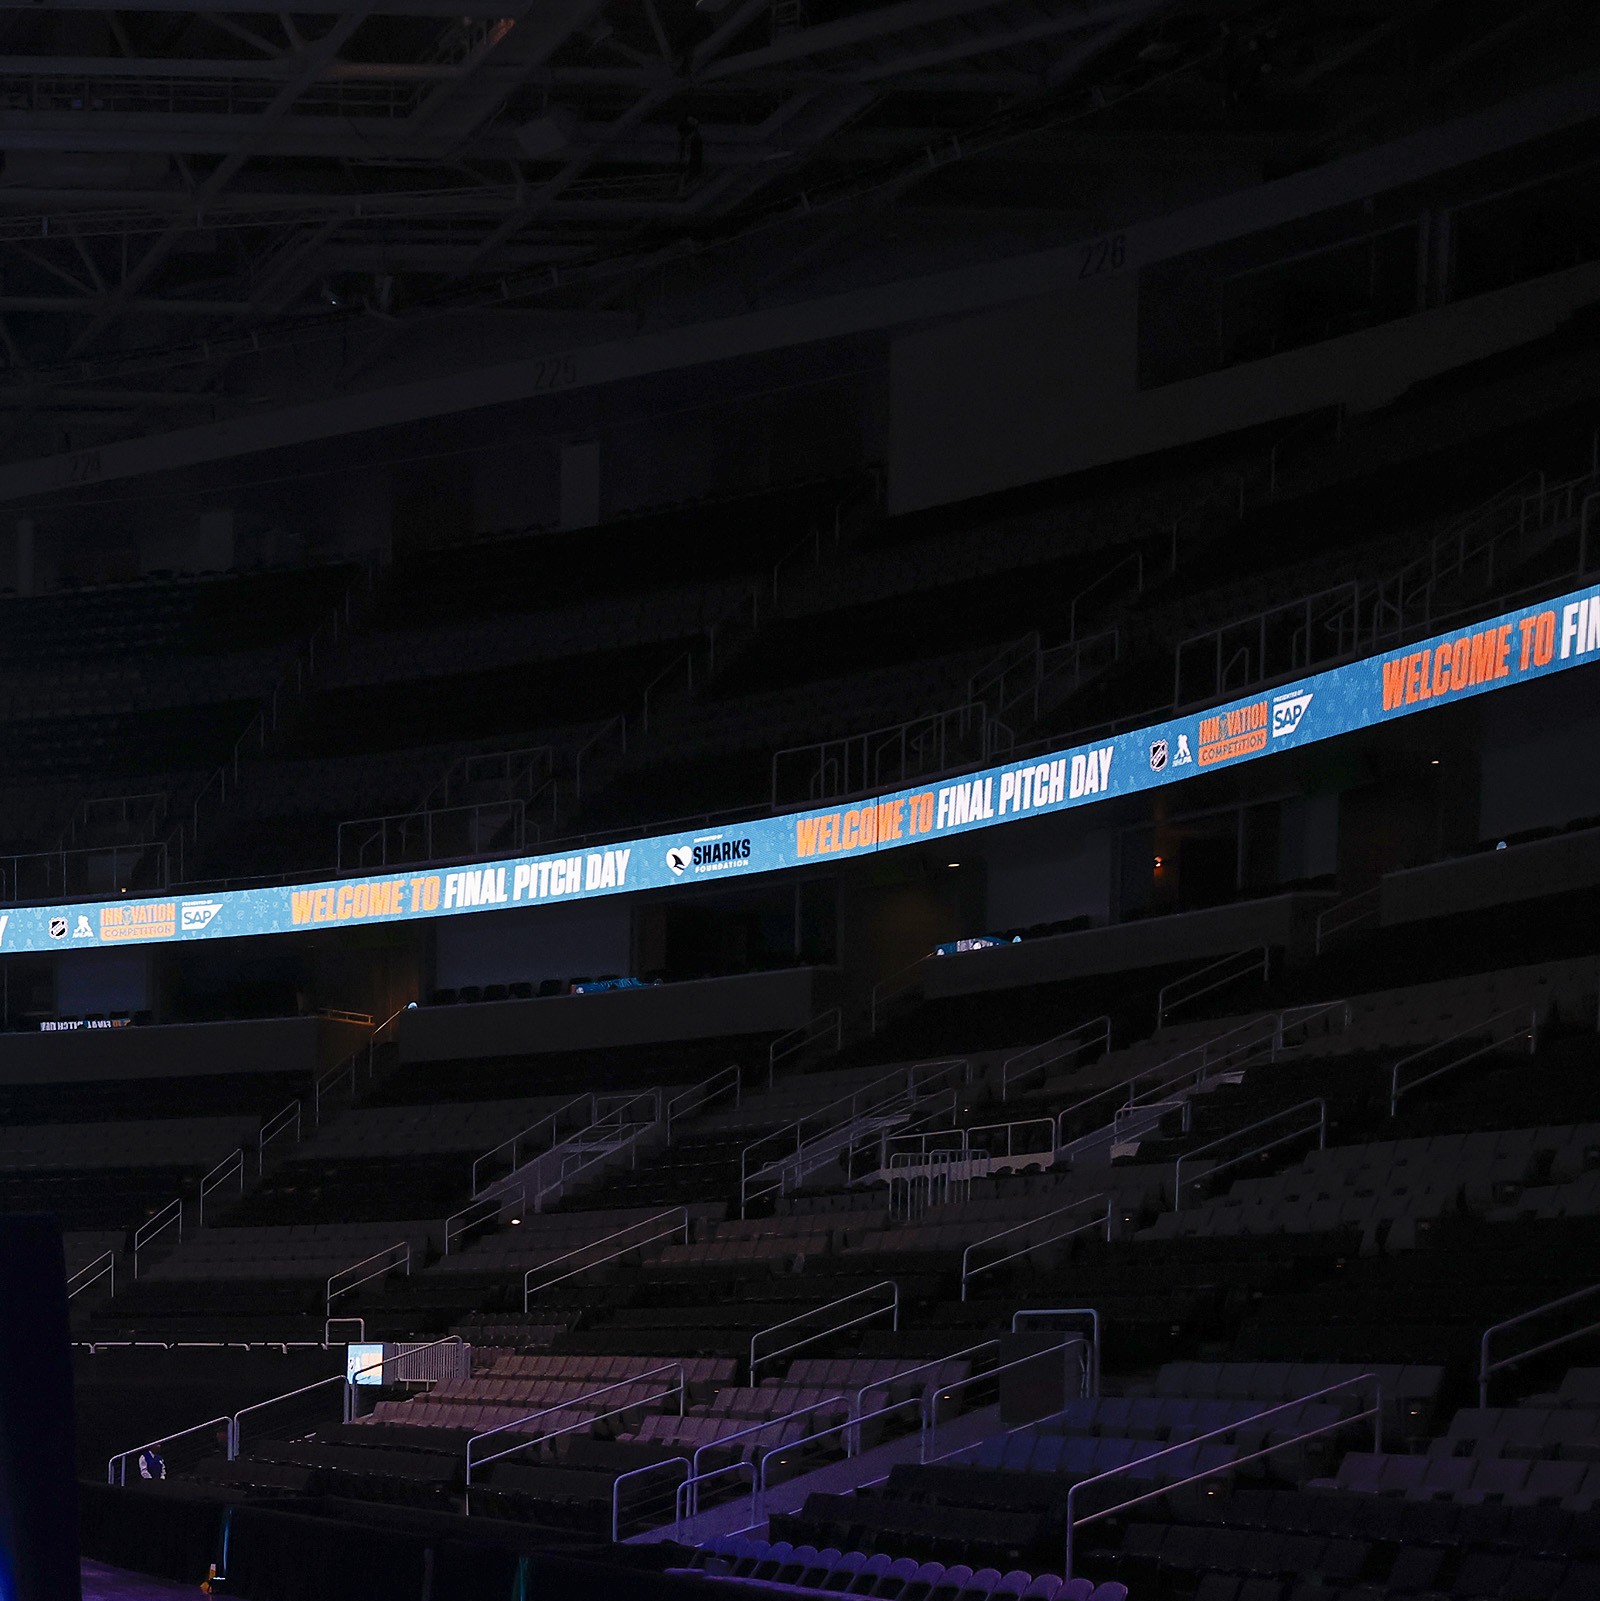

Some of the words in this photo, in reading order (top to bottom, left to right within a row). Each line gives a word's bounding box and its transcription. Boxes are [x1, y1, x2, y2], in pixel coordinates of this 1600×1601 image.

[1382, 623, 1513, 712] WELCOME
[1519, 609, 1558, 672] TO
[1274, 704, 1302, 730] SAP
[1201, 732, 1264, 762] COMPETITION
[796, 798, 904, 858] WELCOME
[907, 790, 935, 834] TO
[936, 776, 994, 830] FINAL
[998, 760, 1065, 816] PITCH
[1069, 744, 1115, 800] DAY
[693, 838, 751, 866] SHARKS
[695, 860, 749, 874] FOUNDATION
[291, 877, 406, 926] WELCOME
[409, 874, 441, 915] TO
[443, 865, 509, 909] FINAL
[513, 860, 582, 901] PITCH
[585, 849, 631, 890] DAY
[104, 925, 171, 938] COMPETITION
[183, 910, 212, 925] SAP
